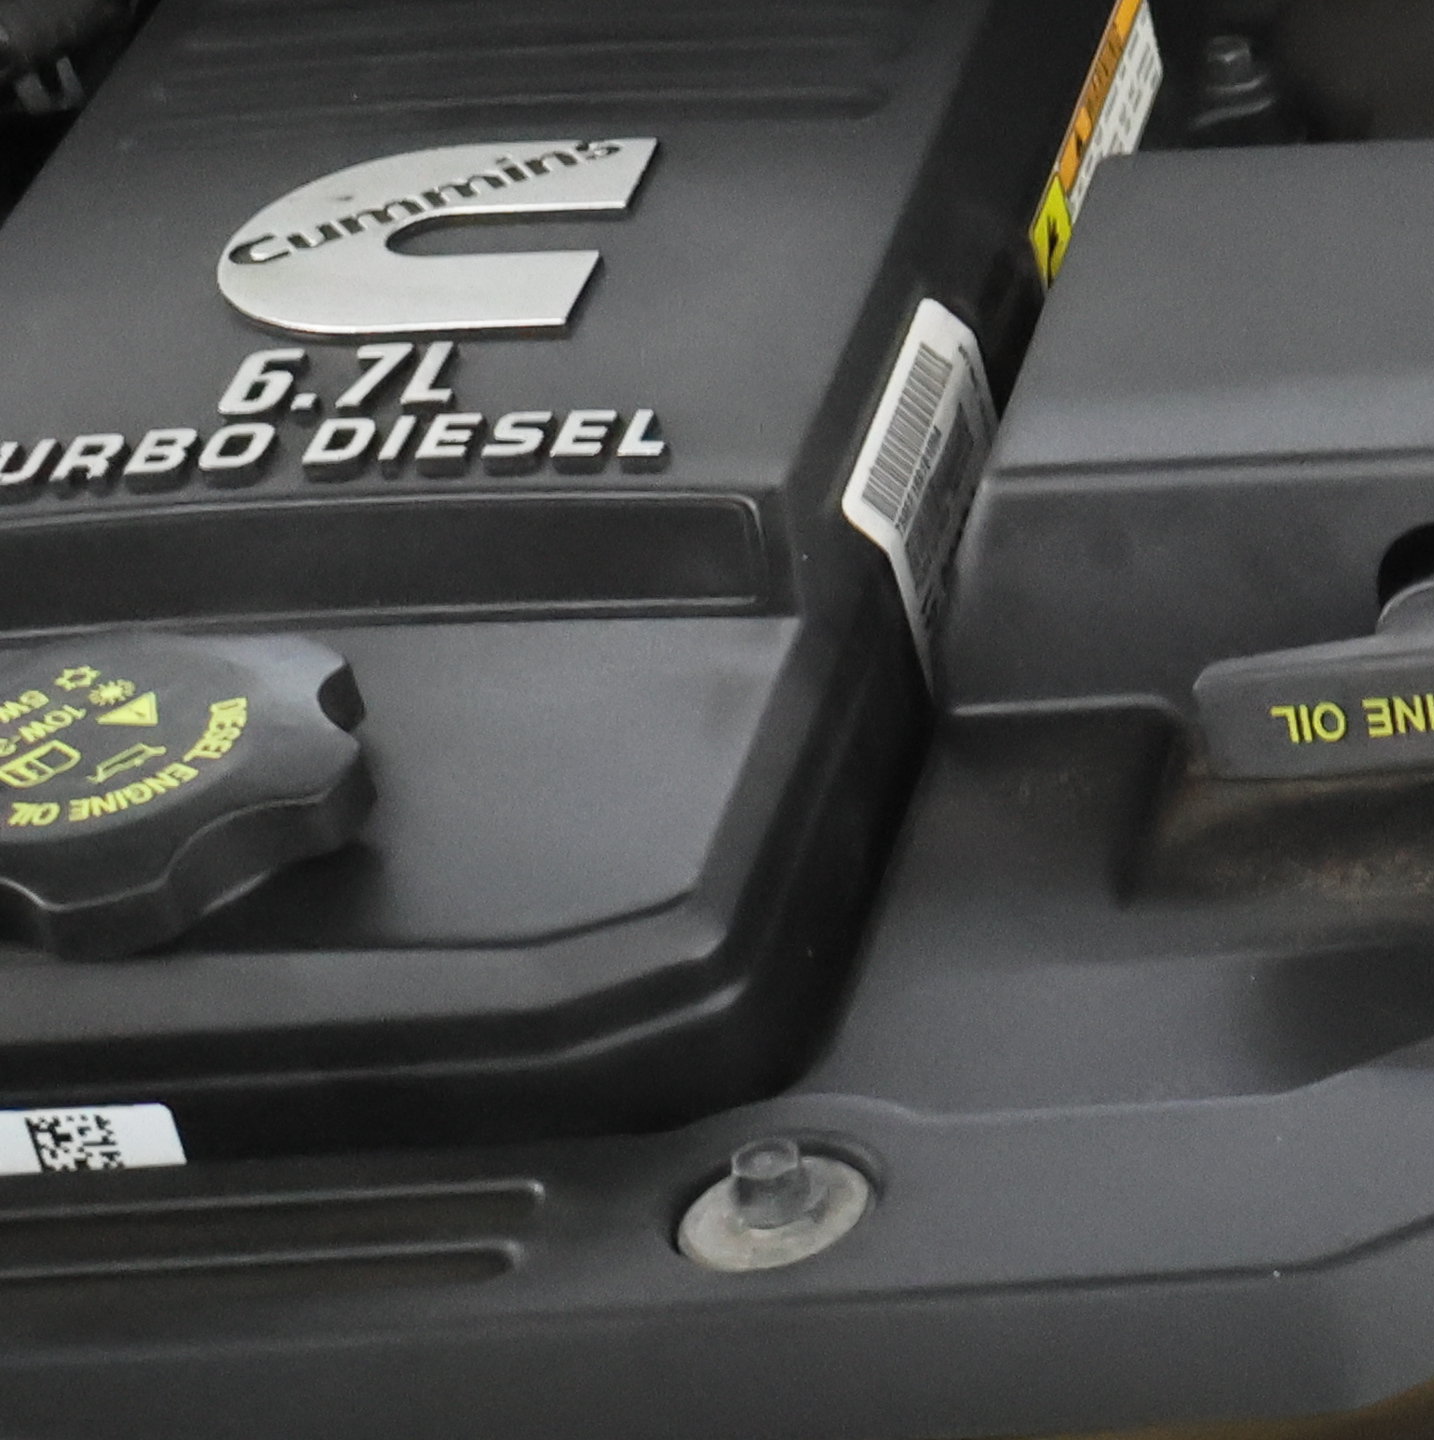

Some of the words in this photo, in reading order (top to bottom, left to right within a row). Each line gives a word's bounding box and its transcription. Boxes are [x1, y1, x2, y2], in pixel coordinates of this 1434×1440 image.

[228, 139, 622, 265] Cummins
[218, 341, 456, 415] 6.7L
[301, 409, 667, 464] DIESEL
[1270, 701, 1347, 744] OIL
